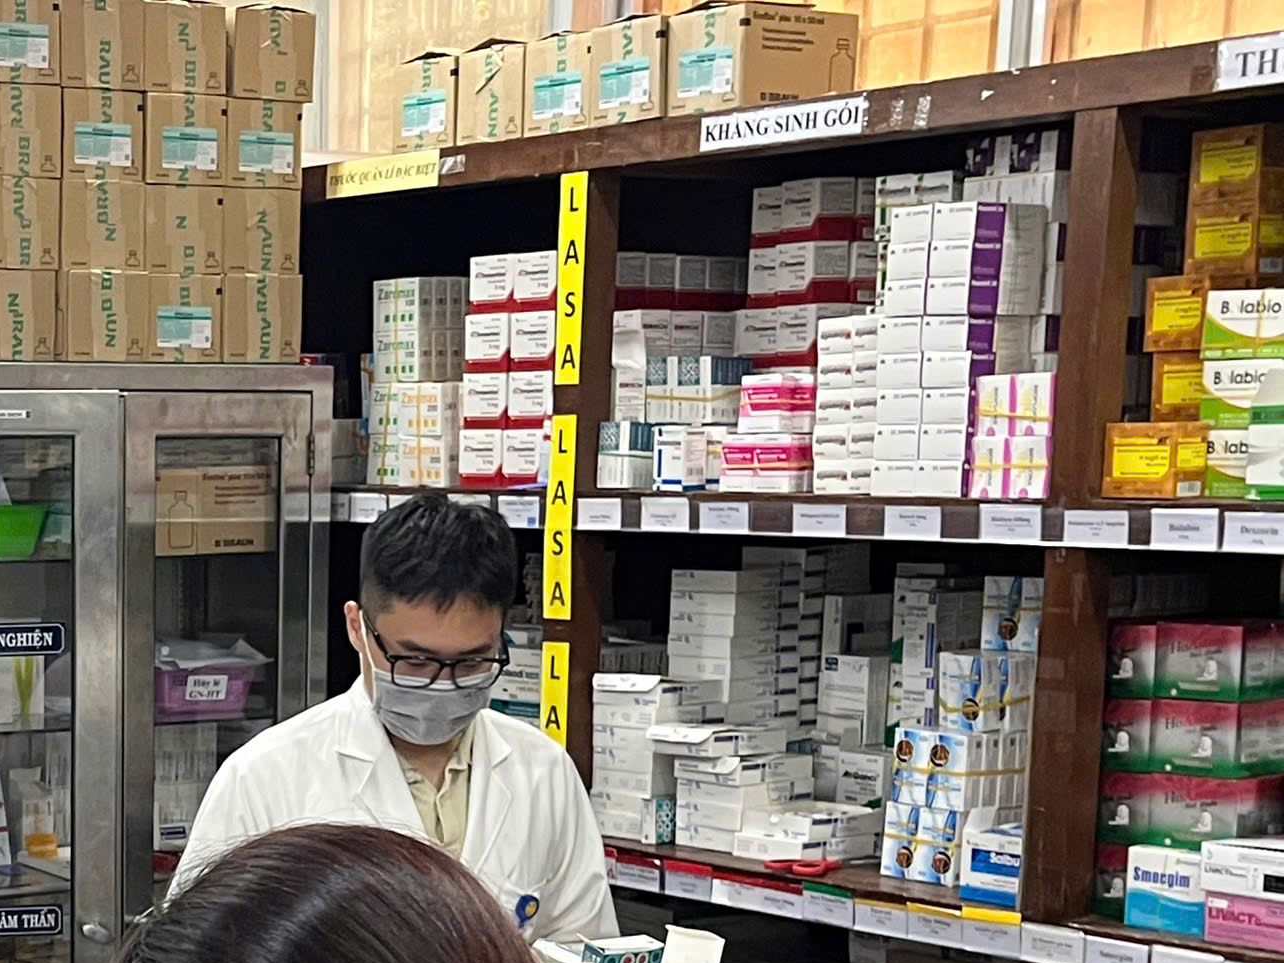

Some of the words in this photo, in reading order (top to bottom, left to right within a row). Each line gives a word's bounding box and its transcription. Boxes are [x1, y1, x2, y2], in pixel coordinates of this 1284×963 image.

[774, 111, 819, 134] SINH
[824, 101, 860, 129] GÓI
[21, 908, 56, 928] THẦN
